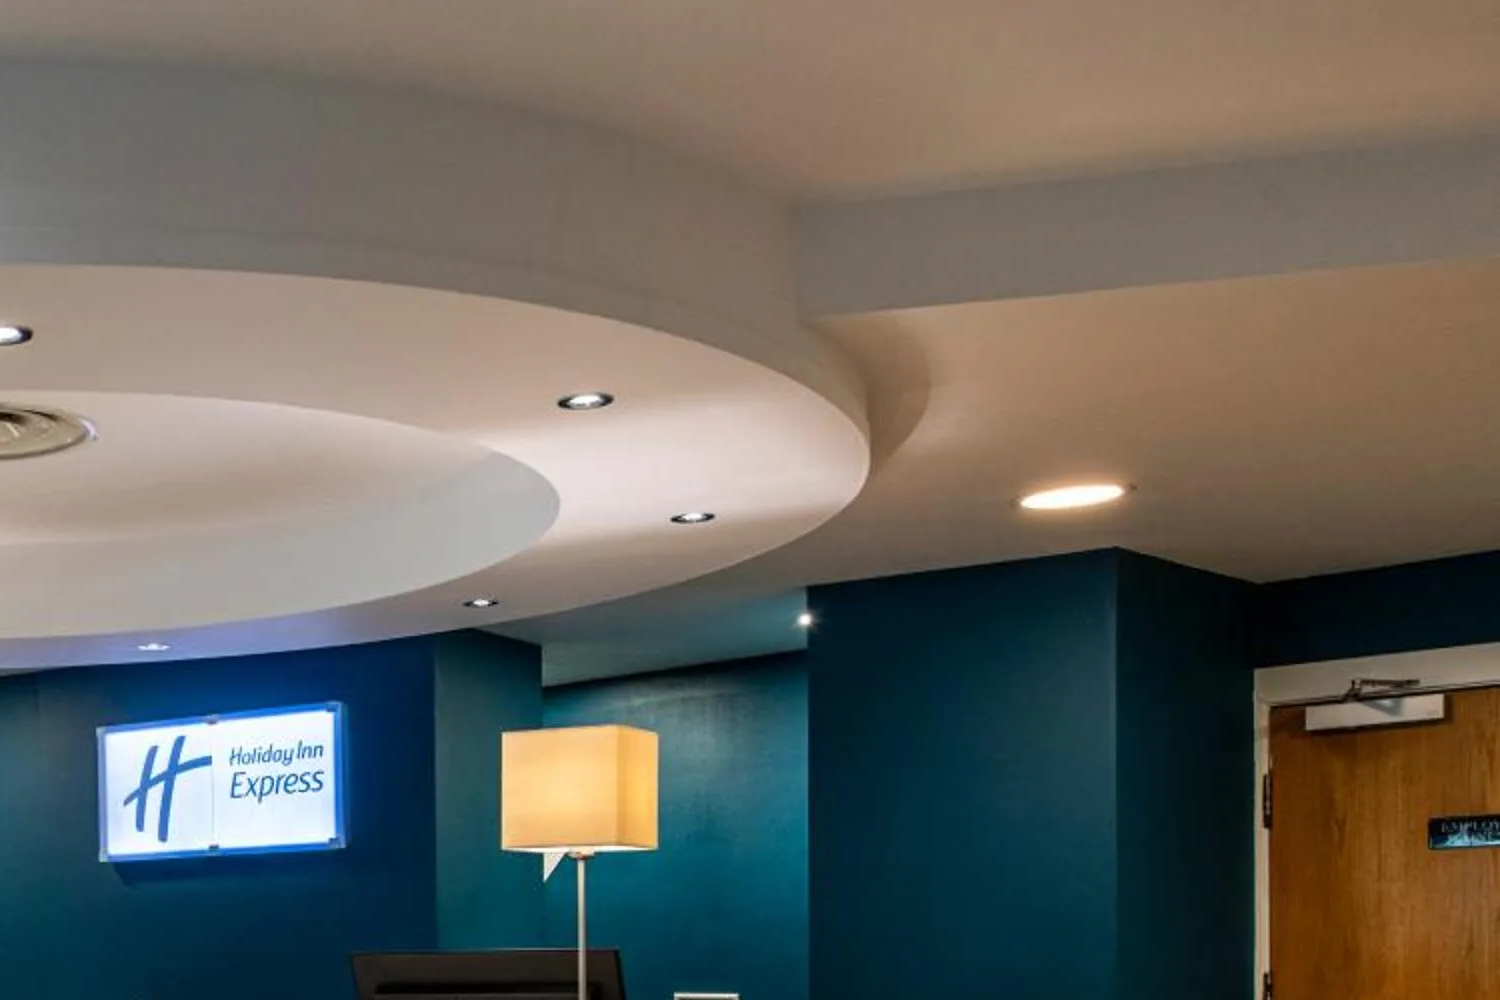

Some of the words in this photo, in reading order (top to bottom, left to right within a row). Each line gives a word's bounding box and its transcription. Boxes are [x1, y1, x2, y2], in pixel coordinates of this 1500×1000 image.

[229, 743, 293, 767] Holiday
[296, 740, 324, 760] Inn
[230, 770, 325, 804] Express
